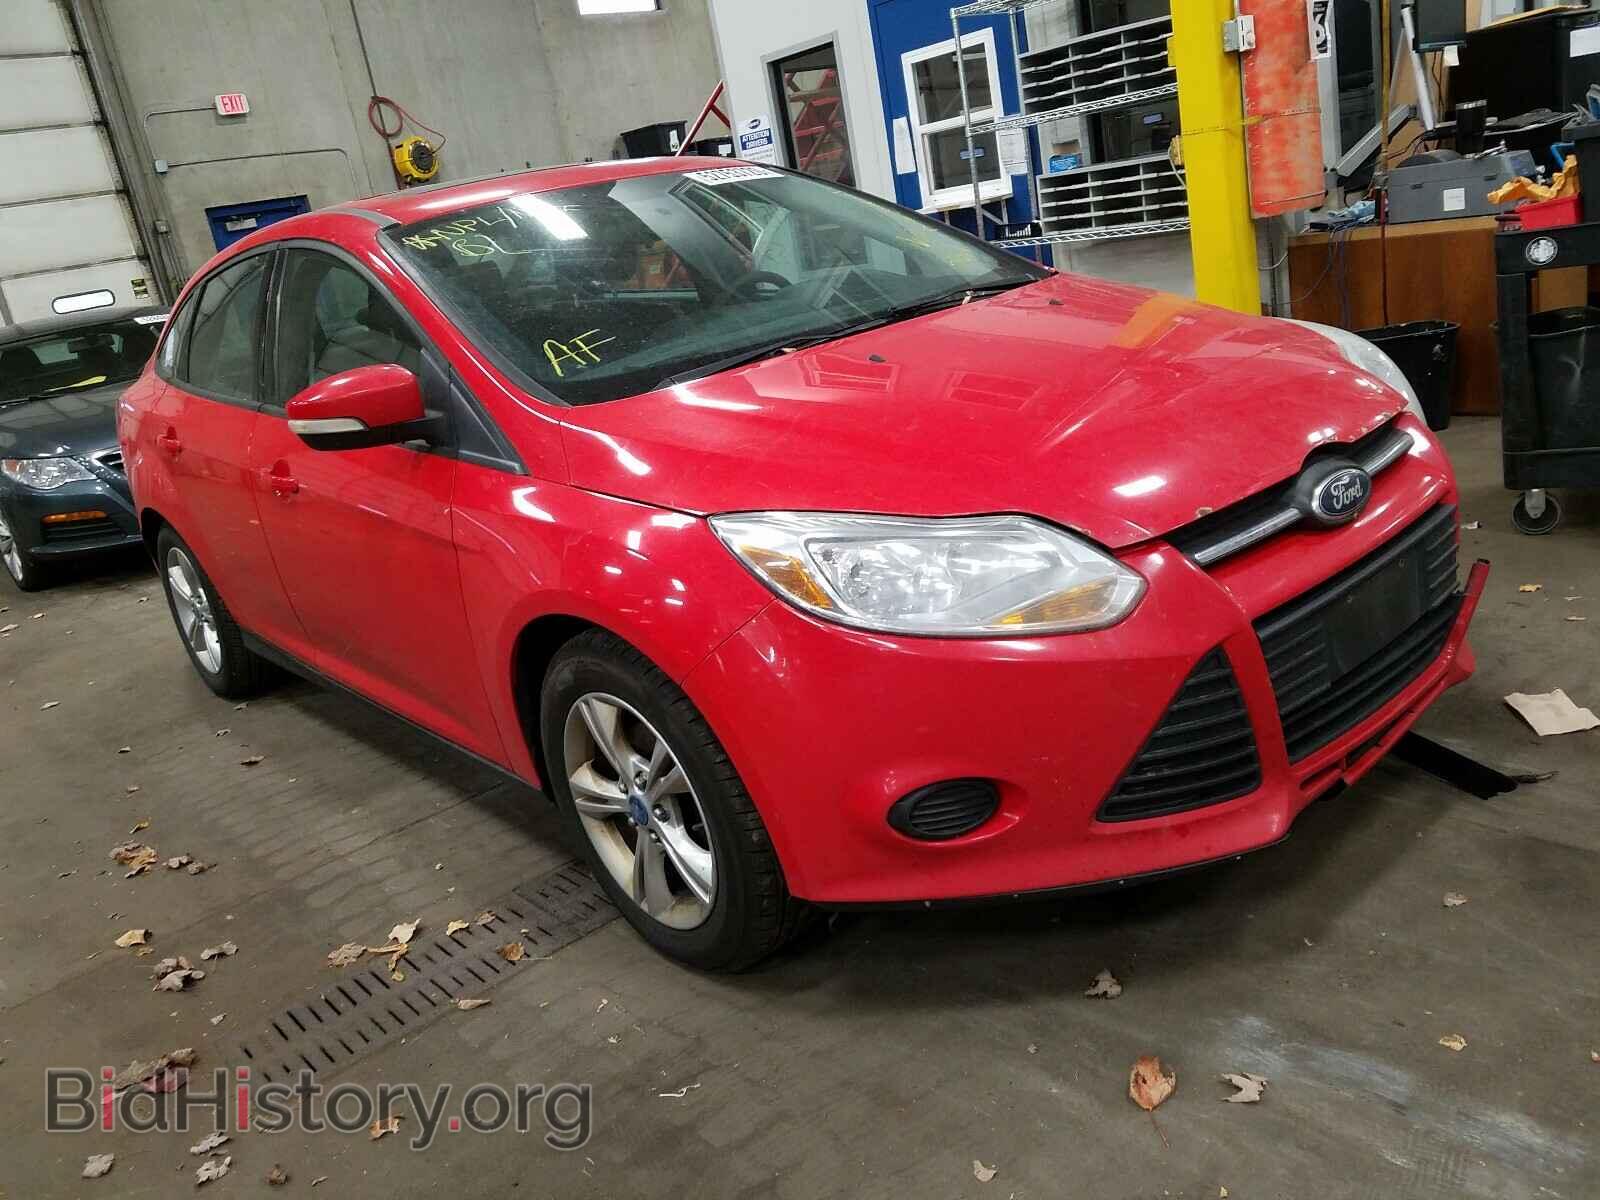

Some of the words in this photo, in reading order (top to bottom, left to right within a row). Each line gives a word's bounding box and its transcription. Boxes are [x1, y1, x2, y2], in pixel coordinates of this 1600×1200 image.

[220, 95, 245, 112] EXIT
[741, 129, 770, 142] ATTENTION
[543, 328, 616, 377] AF
[1331, 475, 1363, 510] Ford
